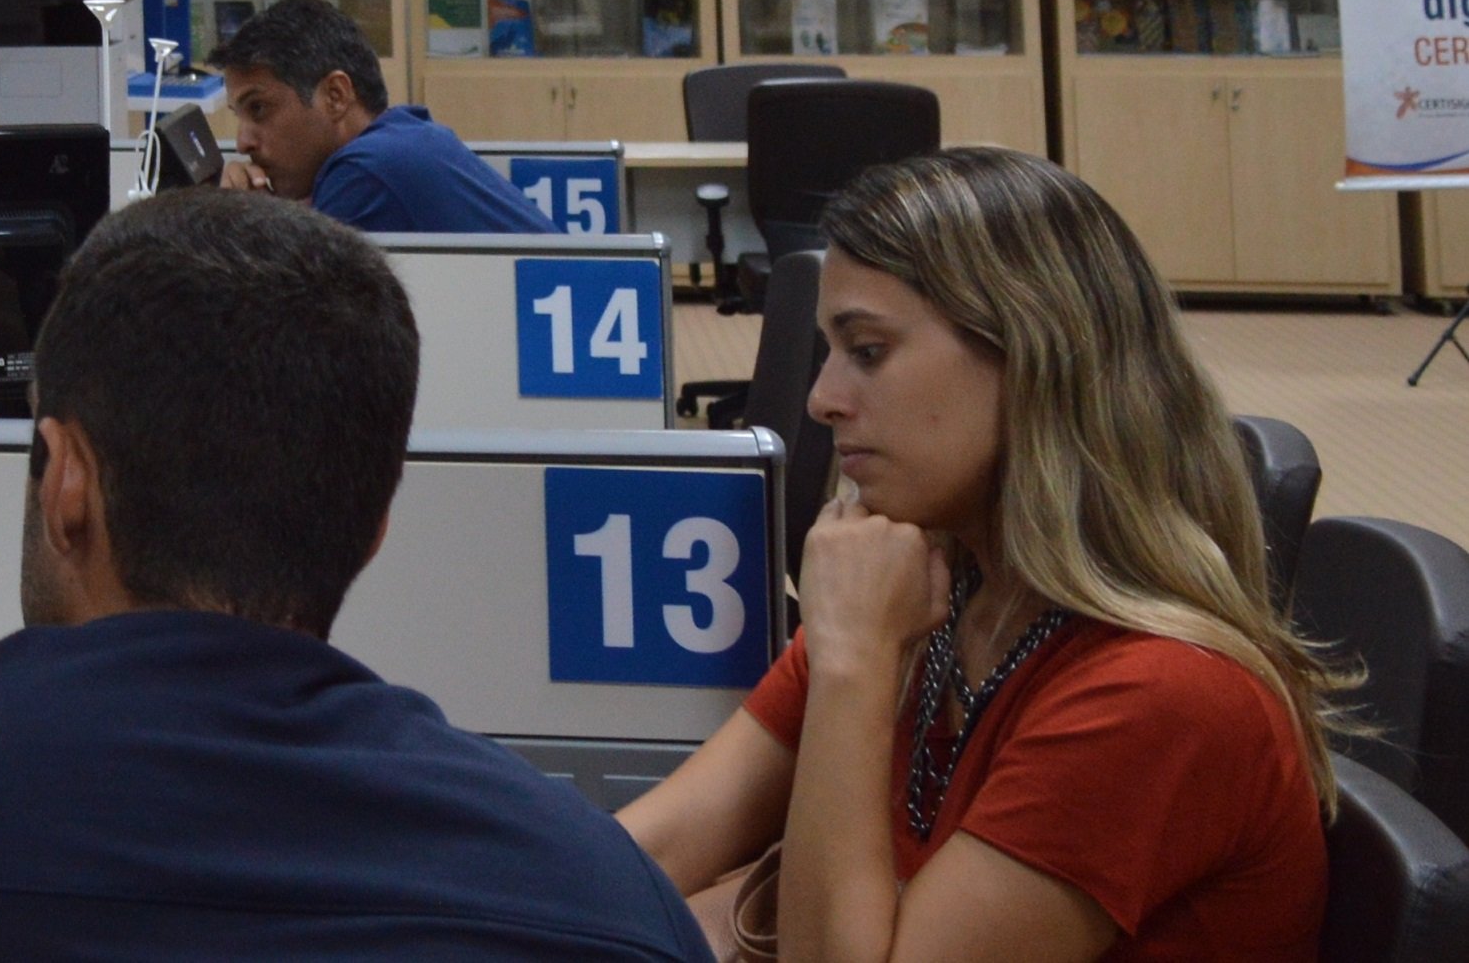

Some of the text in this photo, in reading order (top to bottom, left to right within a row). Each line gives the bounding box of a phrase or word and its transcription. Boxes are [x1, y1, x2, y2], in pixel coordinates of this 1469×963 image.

[1414, 37, 1469, 66] CER
[523, 177, 608, 235] 15
[533, 285, 647, 375] 14
[573, 514, 746, 654] 13
